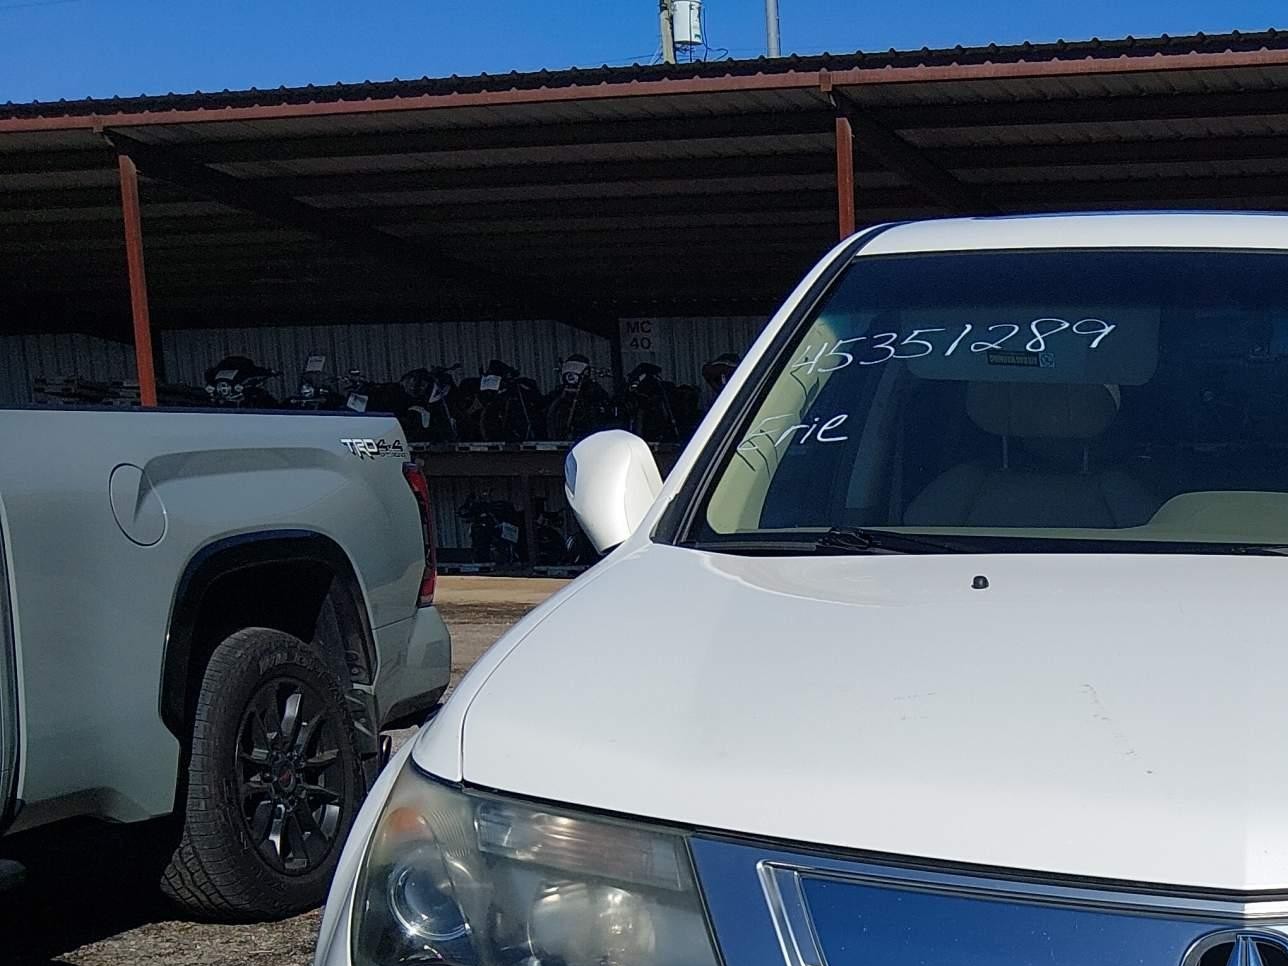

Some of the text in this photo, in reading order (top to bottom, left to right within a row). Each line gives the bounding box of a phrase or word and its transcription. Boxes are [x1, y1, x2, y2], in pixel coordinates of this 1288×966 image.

[626, 320, 652, 333] MC
[630, 336, 651, 350] 40
[790, 318, 1117, 375] 45351289
[736, 413, 849, 452] Erie
[339, 438, 379, 461] TRD
